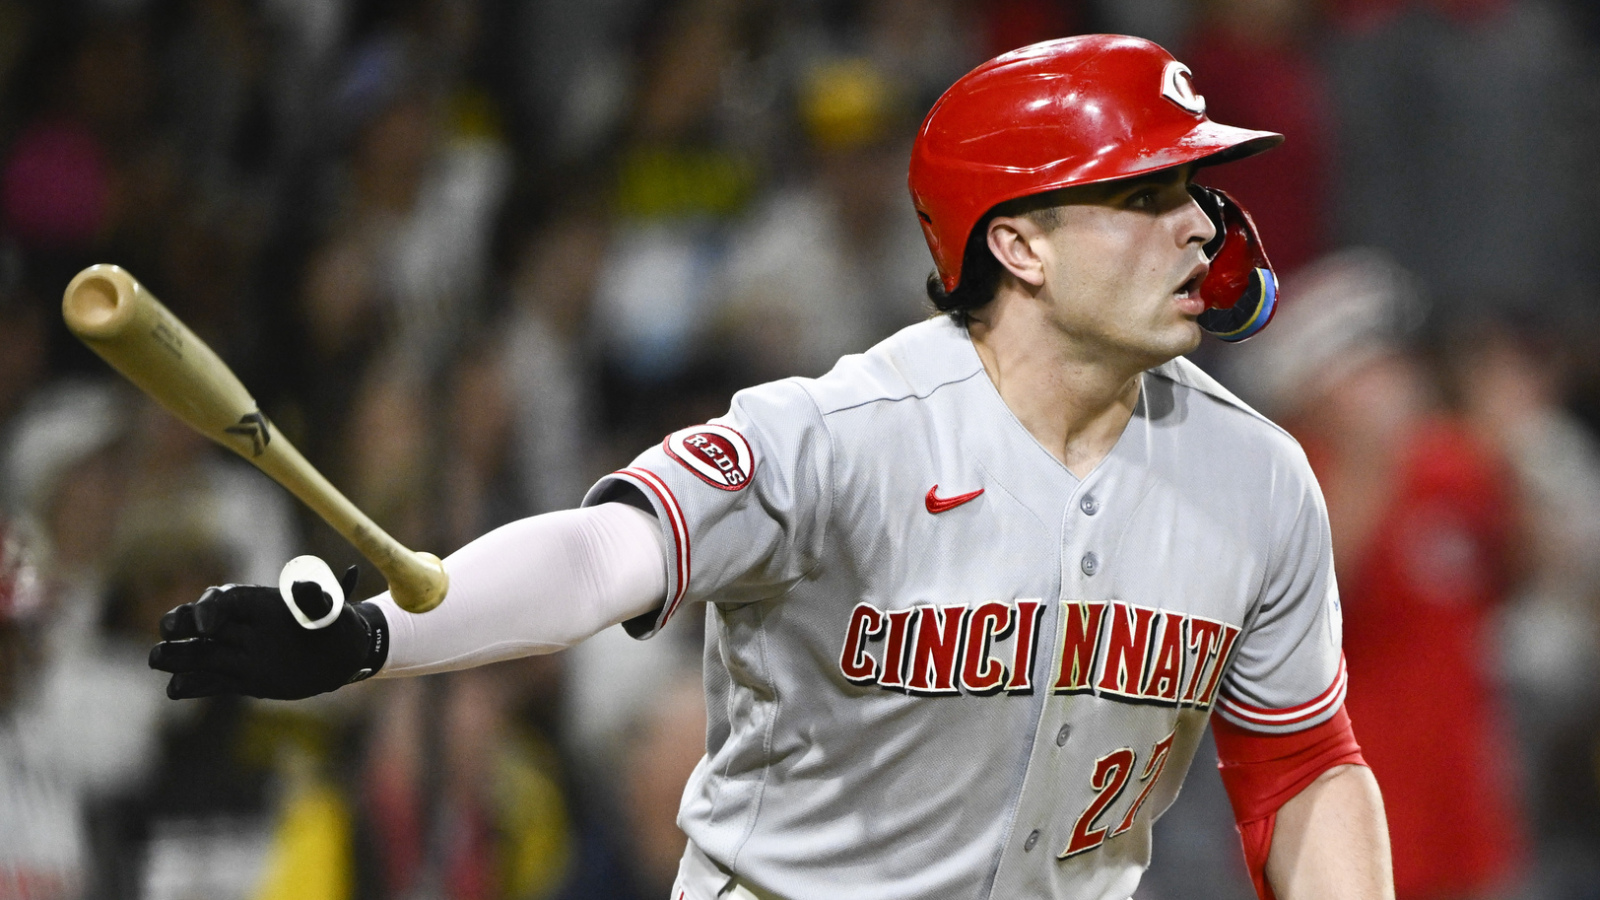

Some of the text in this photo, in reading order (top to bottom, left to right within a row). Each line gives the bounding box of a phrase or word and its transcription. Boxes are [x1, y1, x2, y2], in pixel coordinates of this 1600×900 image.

[685, 434, 745, 486] REDS
[840, 598, 1243, 708] CINCINNATI
[1057, 722, 1181, 860] 27
